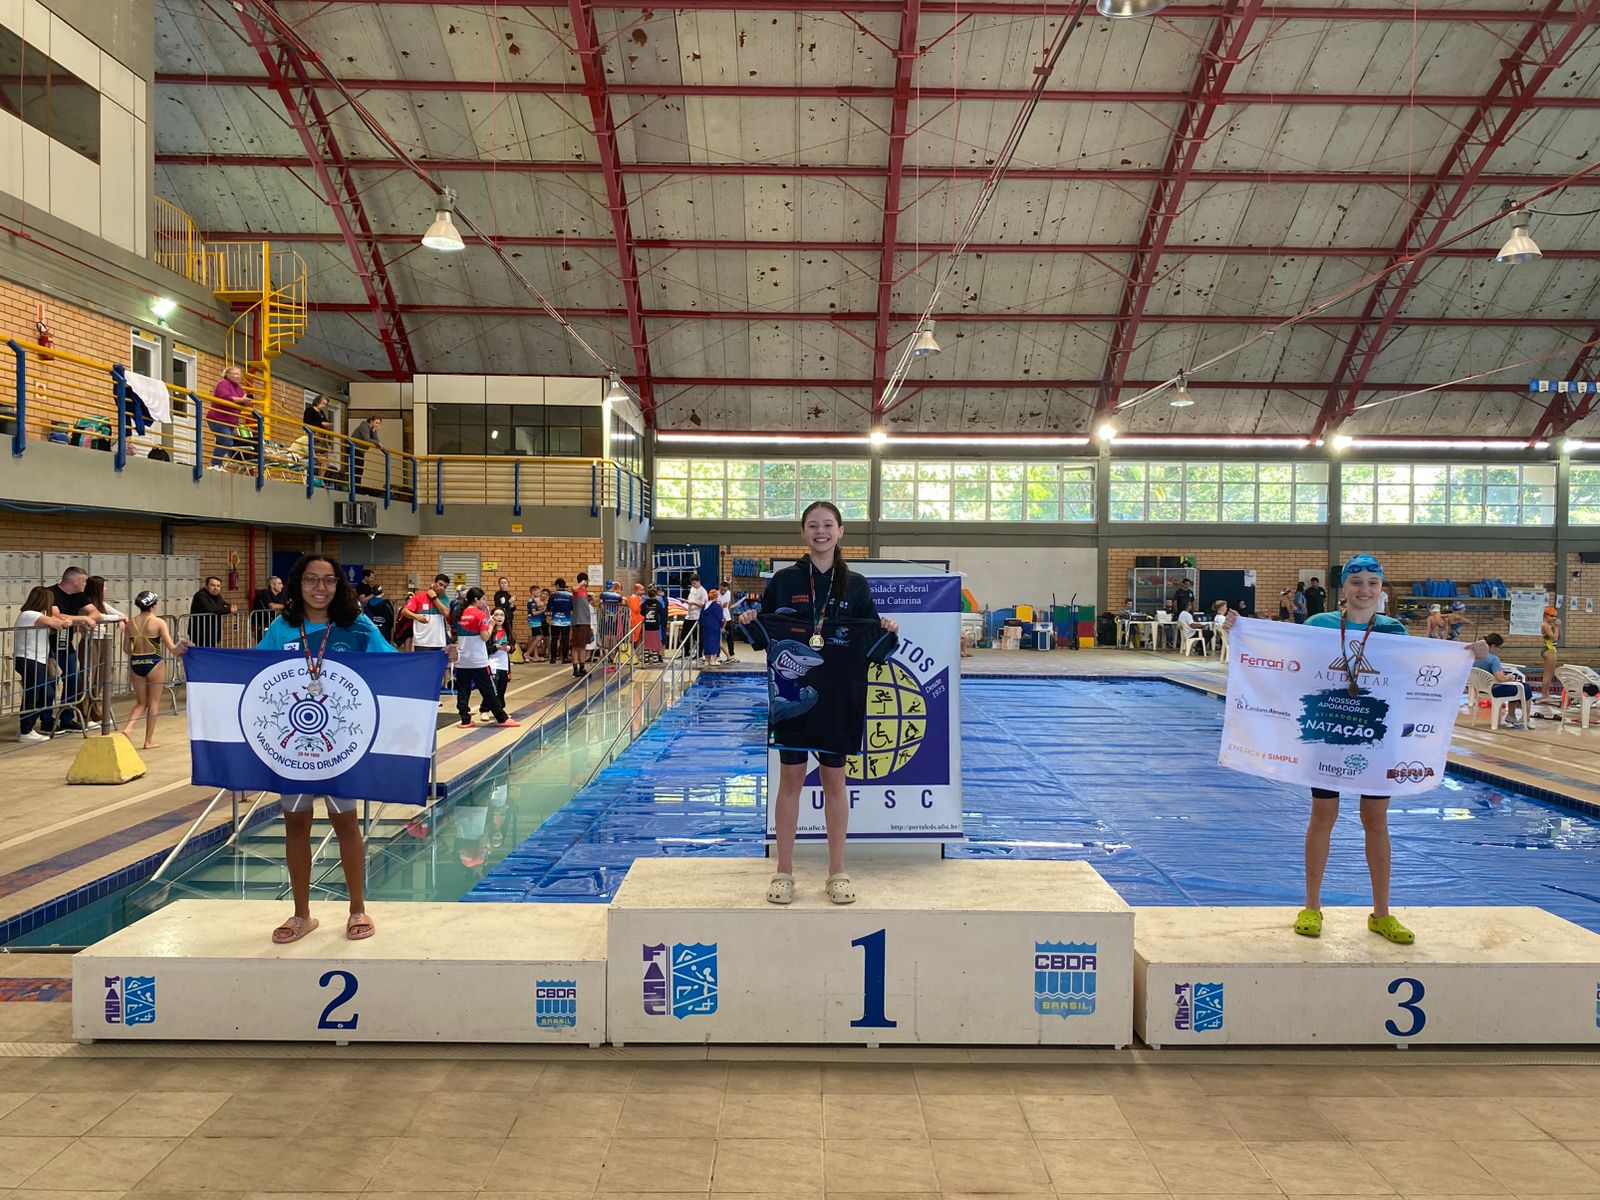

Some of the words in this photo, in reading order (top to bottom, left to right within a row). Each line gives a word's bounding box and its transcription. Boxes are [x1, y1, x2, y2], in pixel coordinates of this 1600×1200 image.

[871, 585, 896, 593] sidade
[899, 584, 929, 593] Federal
[872, 597, 885, 605] nta
[887, 597, 921, 605] Catarina
[900, 638, 934, 673] TOS
[1240, 653, 1284, 669] Ferrari
[263, 669, 295, 691] CLUBE
[298, 668, 327, 678] CAA
[330, 672, 338, 681] E
[337, 676, 359, 697] TIRO
[925, 678, 942, 693] Desde
[1314, 670, 1389, 687] AUDTAR
[932, 686, 946, 699] 1973
[1318, 701, 1370, 714] APOIADORES
[1328, 696, 1361, 706] NOSSOS
[1315, 712, 1368, 724] ATIRADORES
[1305, 719, 1375, 738] NATAÇÃO
[1415, 723, 1435, 733] CDL
[257, 732, 315, 770] VASCONCELOS
[317, 741, 358, 770] DRUMOND
[1267, 752, 1299, 764] SIMPLE
[1318, 761, 1358, 777] Integrar
[1034, 954, 1097, 971] CBDA
[850, 928, 897, 1028] 1
[317, 970, 359, 1030] 2
[536, 988, 576, 999] CBDA
[1042, 1001, 1089, 1010] BRASIL
[1384, 977, 1427, 1037] 3
